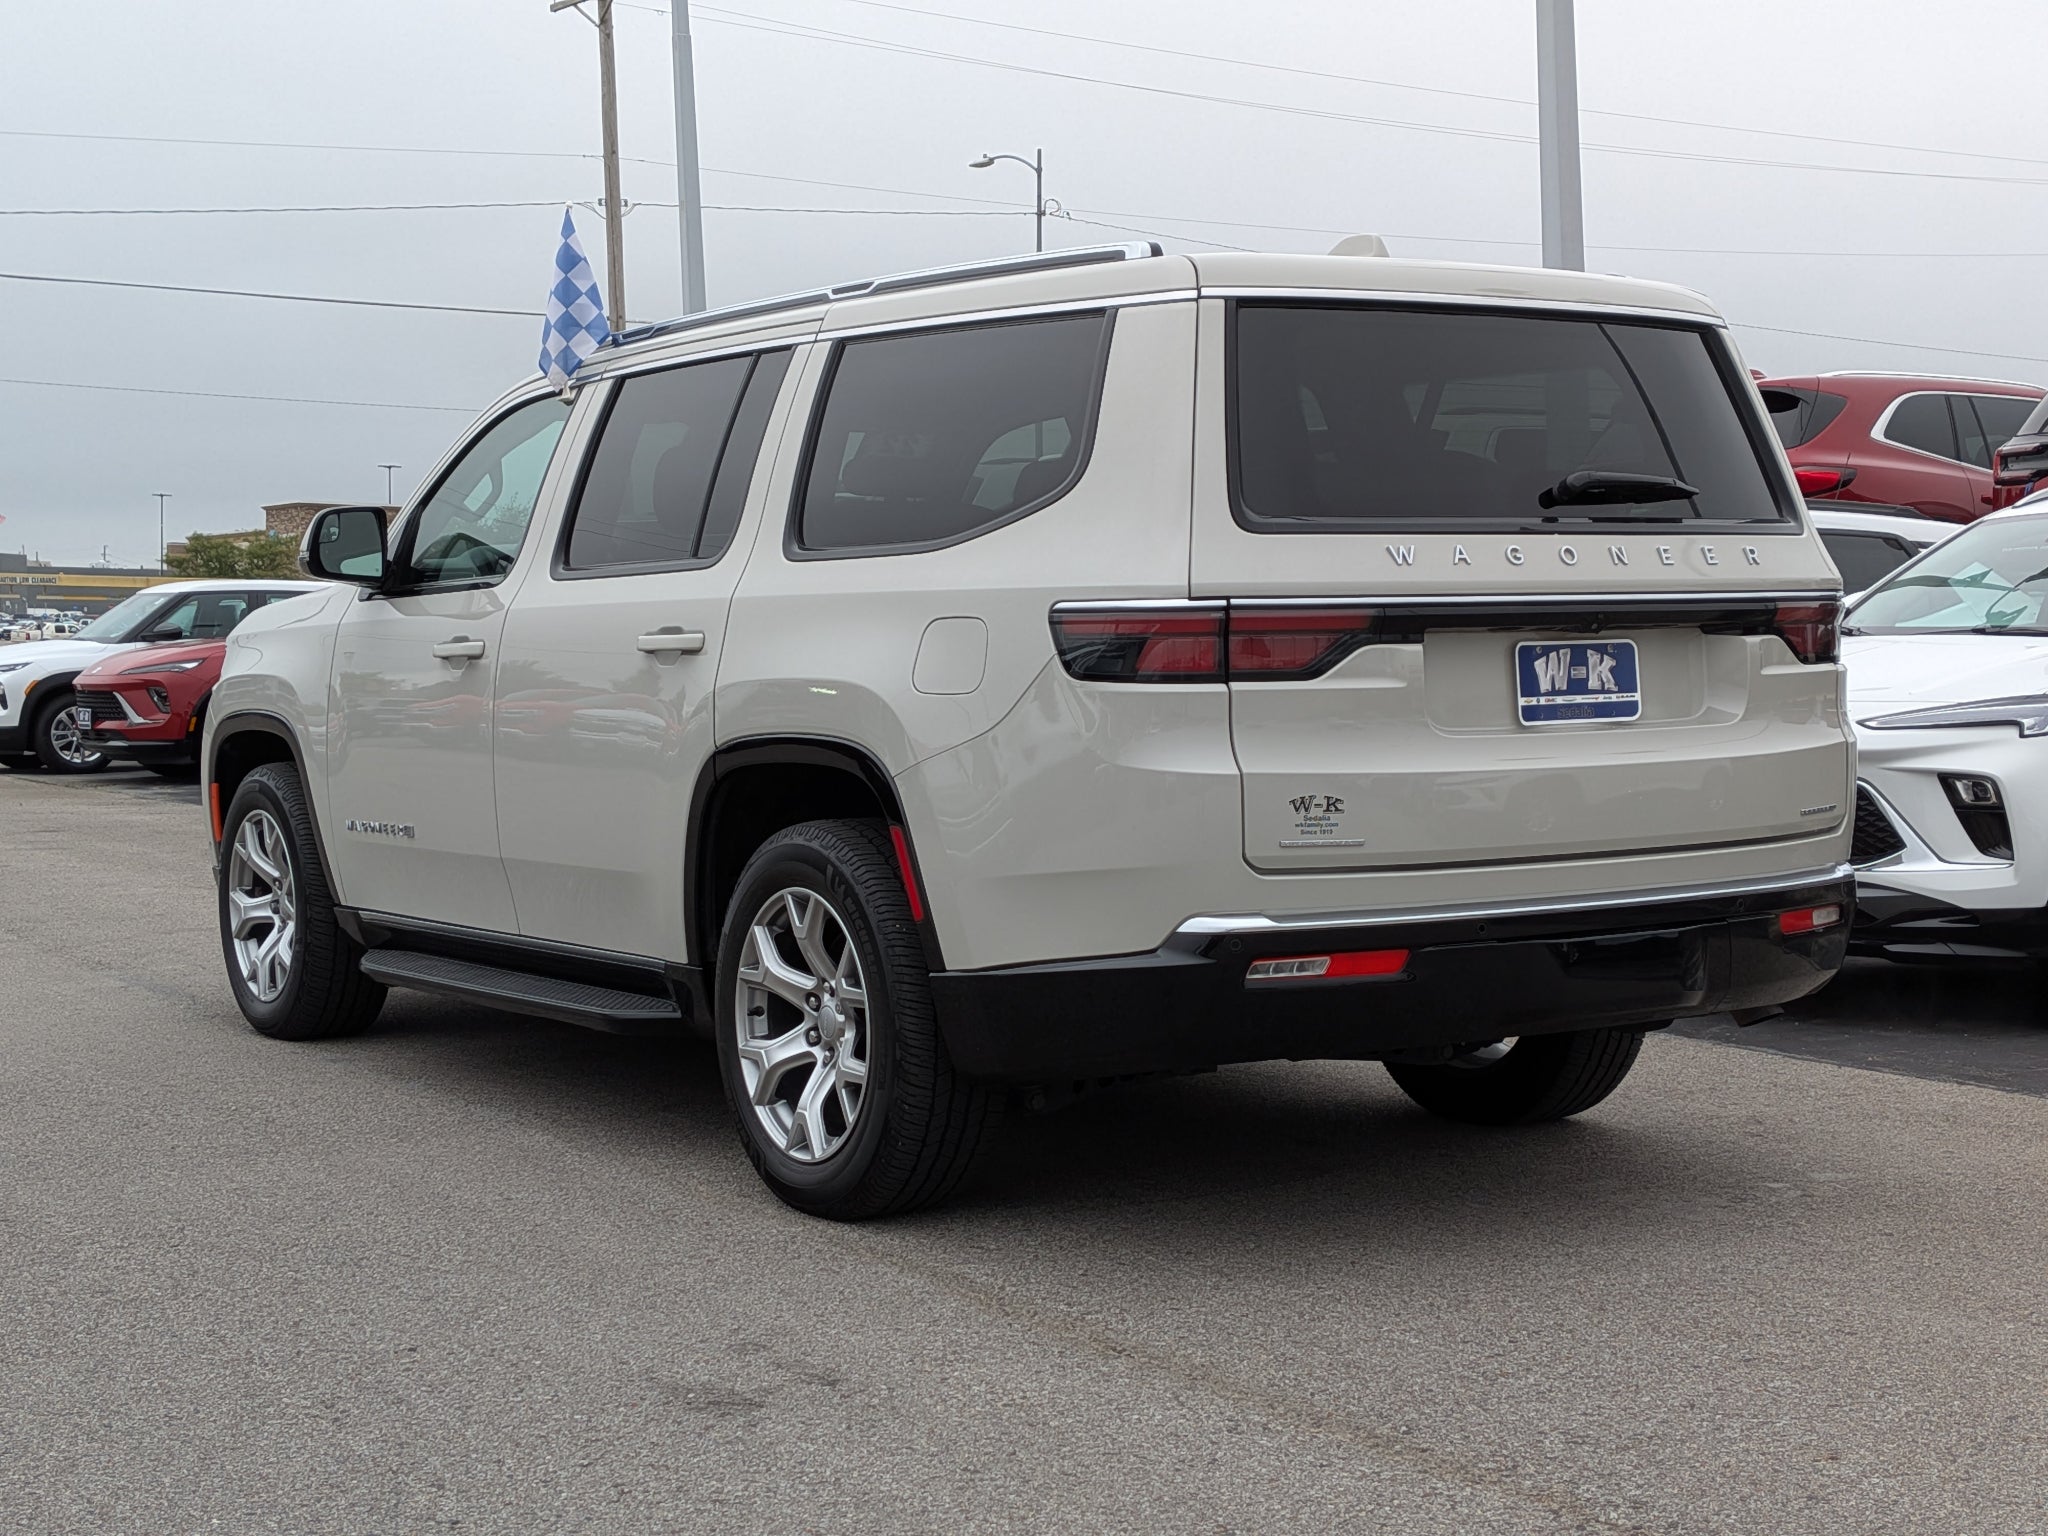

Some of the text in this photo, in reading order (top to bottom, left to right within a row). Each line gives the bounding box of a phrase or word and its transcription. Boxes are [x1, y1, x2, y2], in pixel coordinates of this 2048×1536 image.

[1386, 544, 1761, 566] WAGONEER
[31, 577, 57, 585] CLEARANCE
[1533, 647, 1619, 694] W-K
[1558, 706, 1595, 719] Sedalia
[1288, 794, 1345, 815] W-K
[1303, 814, 1331, 822] Sedalia
[1294, 821, 1339, 829] wkfamily.com
